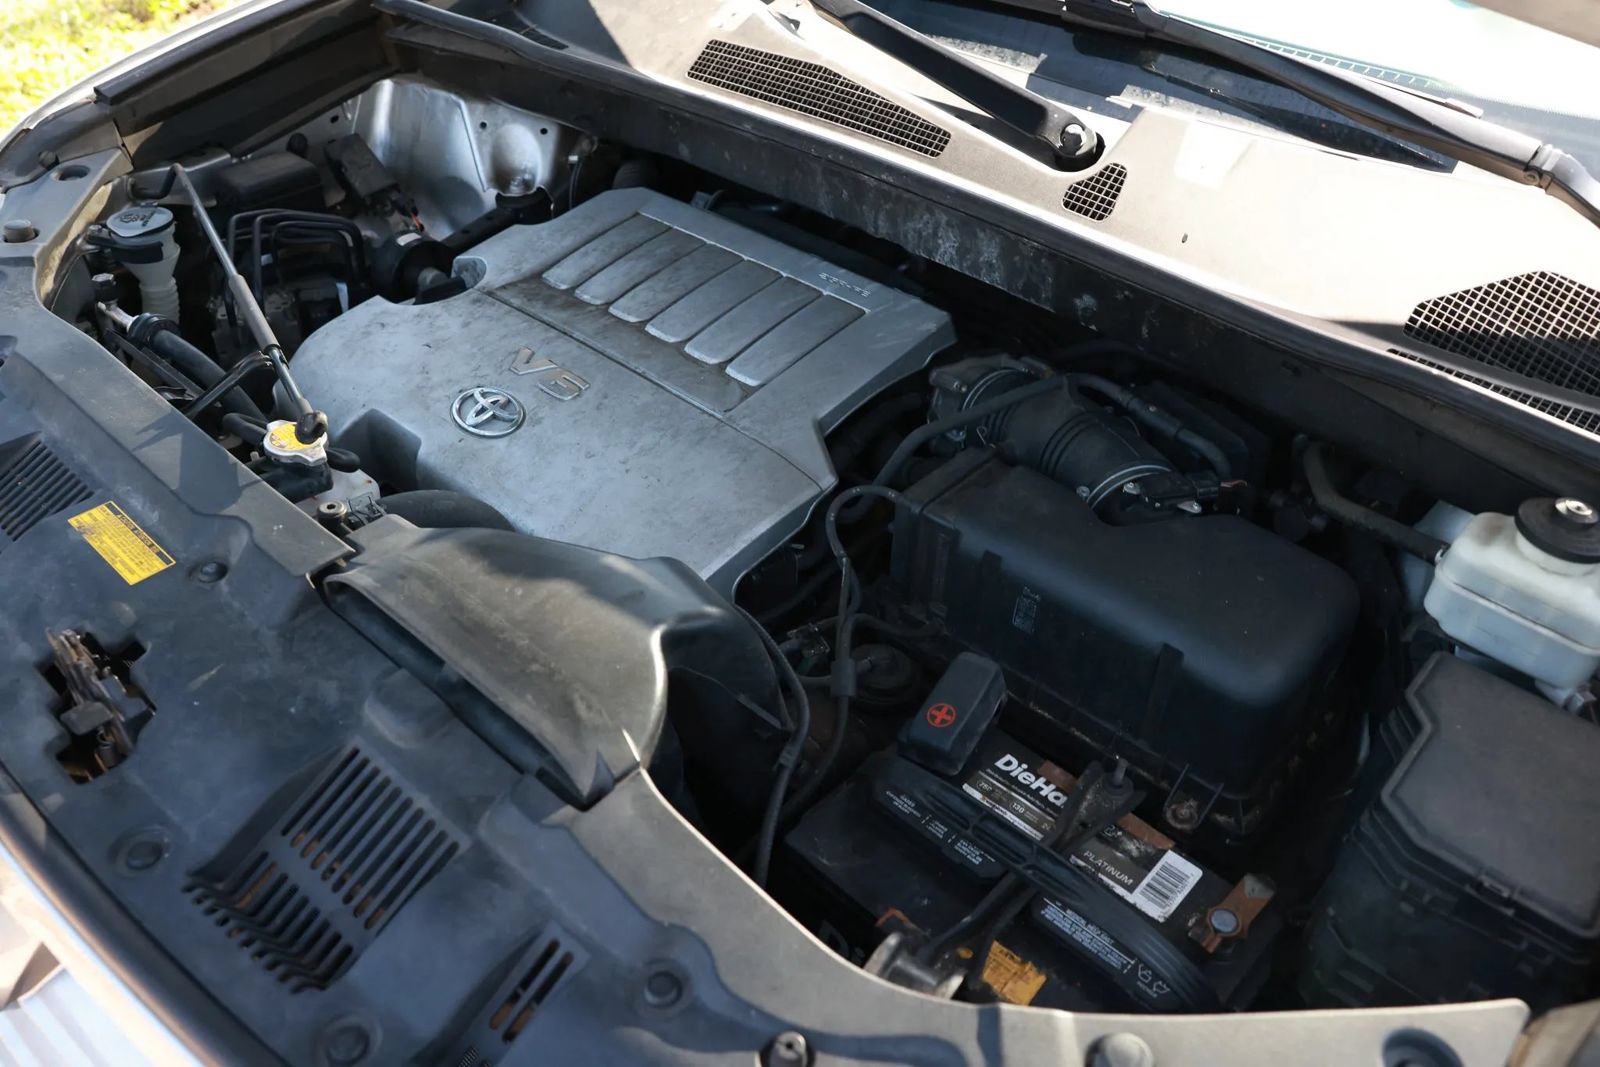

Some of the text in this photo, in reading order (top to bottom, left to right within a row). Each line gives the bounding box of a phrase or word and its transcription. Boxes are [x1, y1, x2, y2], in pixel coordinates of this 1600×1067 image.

[509, 347, 591, 401] V6
[994, 753, 1068, 808] DieHa
[1082, 850, 1135, 887] PLATINUM
